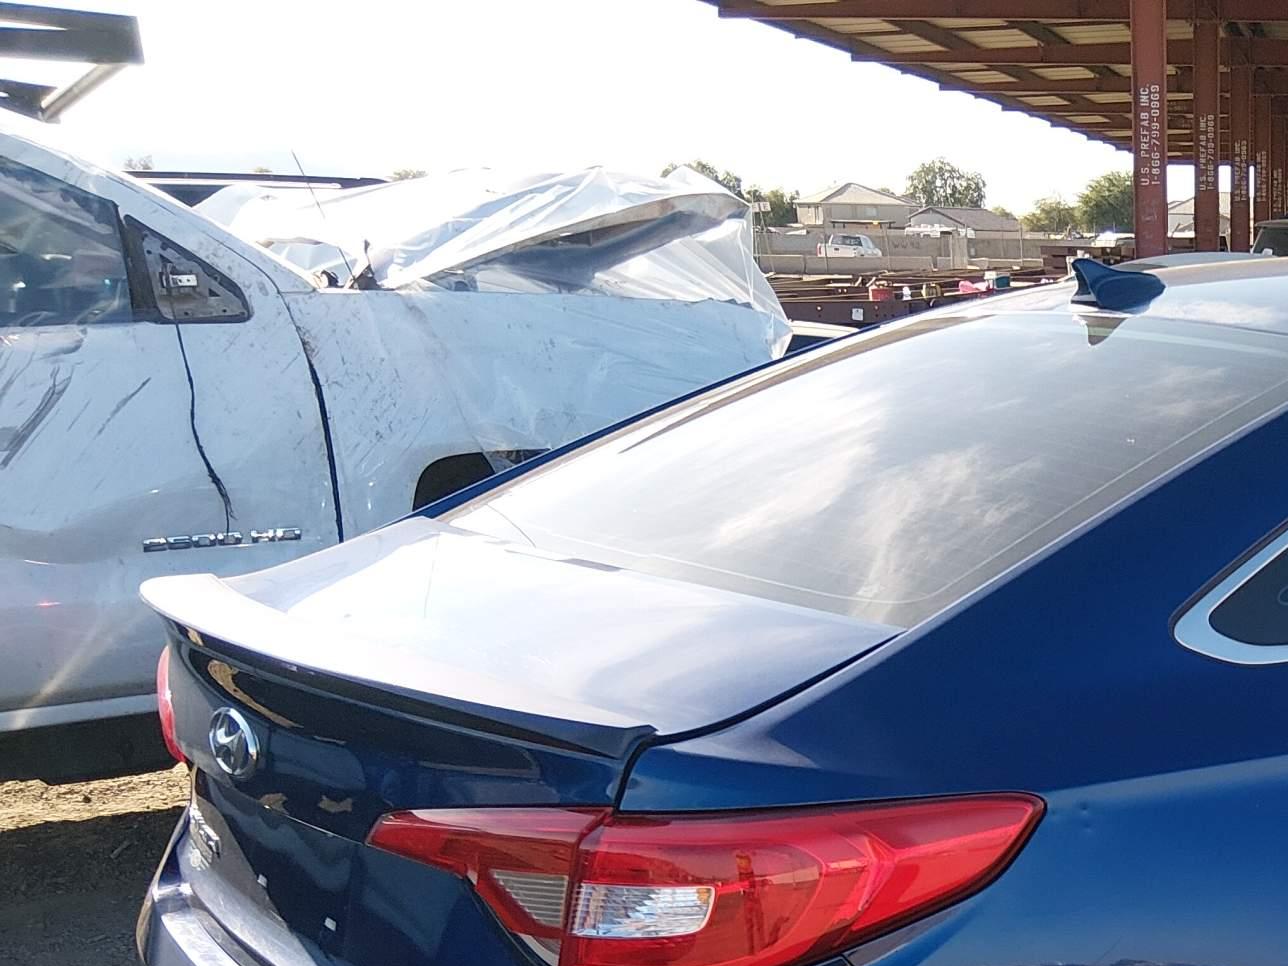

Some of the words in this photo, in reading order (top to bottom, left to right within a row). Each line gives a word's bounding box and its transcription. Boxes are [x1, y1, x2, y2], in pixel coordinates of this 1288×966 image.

[1139, 83, 1150, 107] INC.
[1139, 112, 1150, 158] PREFAB
[1139, 163, 1150, 186] U.S.
